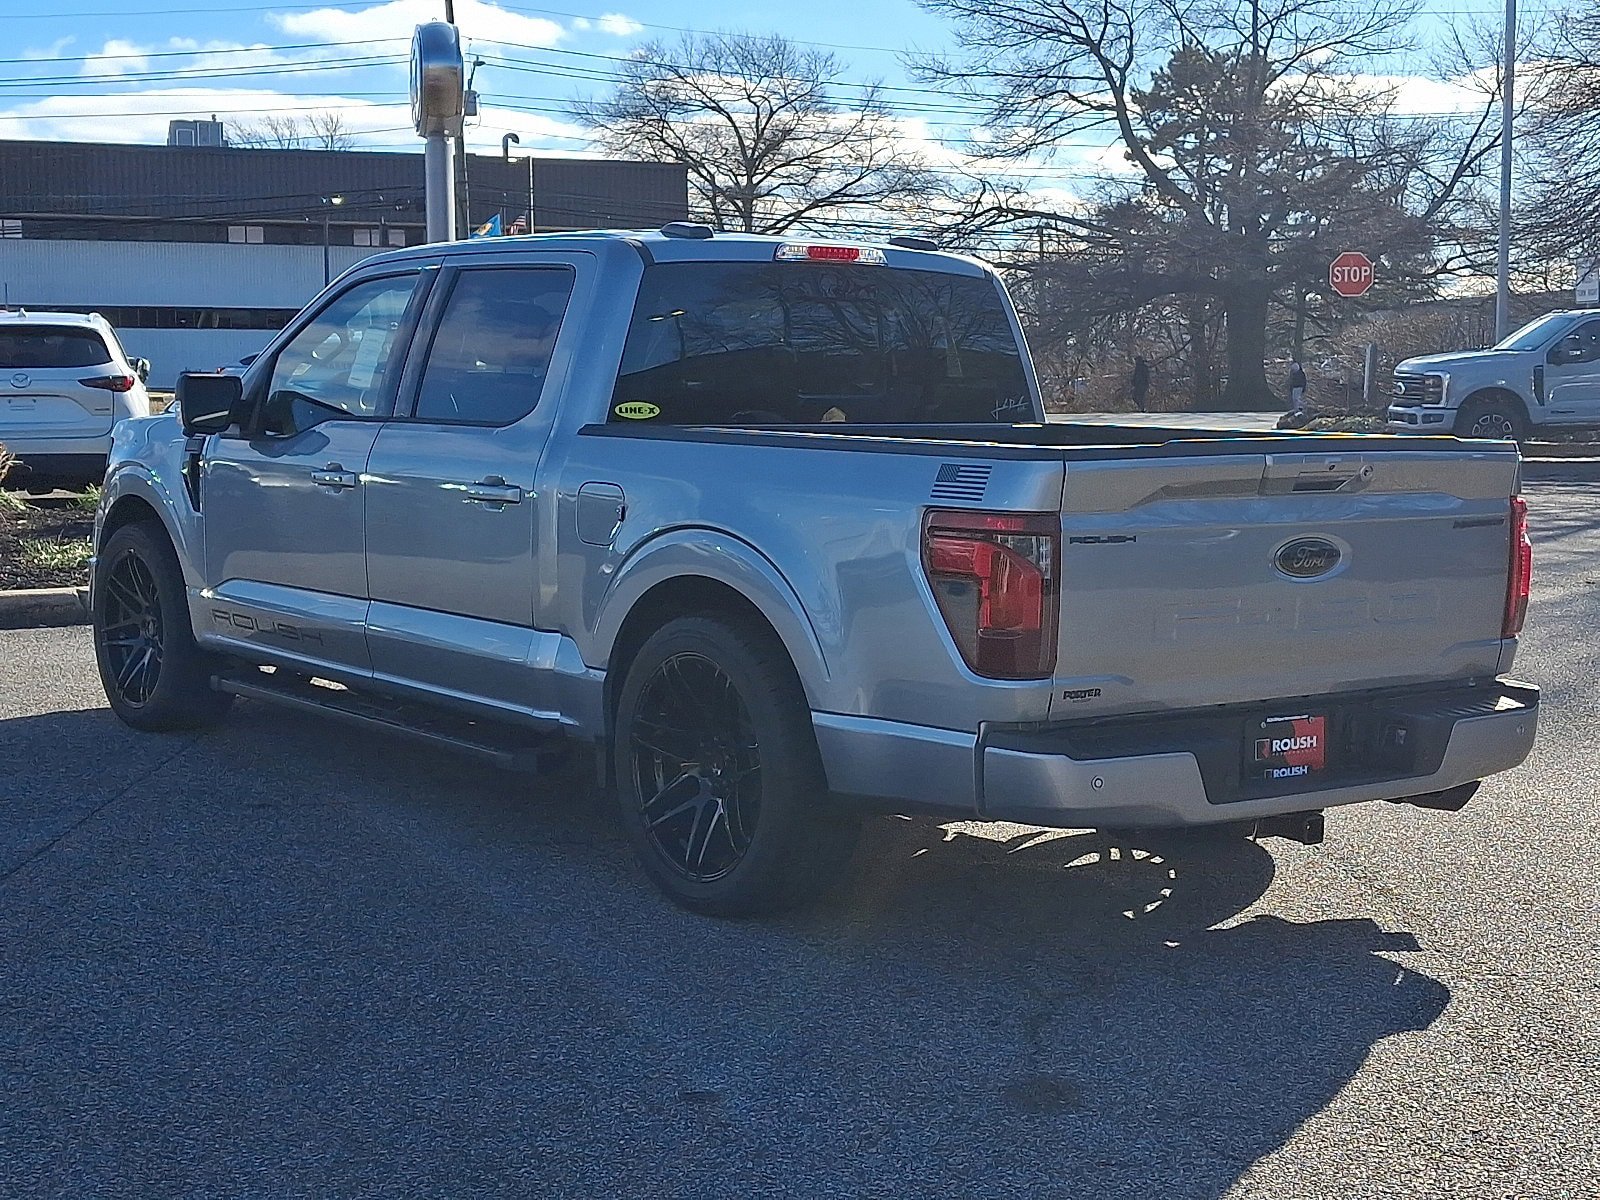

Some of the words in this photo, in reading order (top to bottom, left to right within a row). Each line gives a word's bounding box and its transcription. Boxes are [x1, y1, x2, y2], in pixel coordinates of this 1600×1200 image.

[1332, 266, 1370, 283] STOP
[618, 406, 656, 415] LINE-X
[1292, 546, 1328, 568] Ford
[211, 608, 325, 647] ROUSH
[1062, 687, 1103, 700] PORTER
[1271, 735, 1318, 752] ROUSH
[1272, 765, 1308, 779] ROUSH
